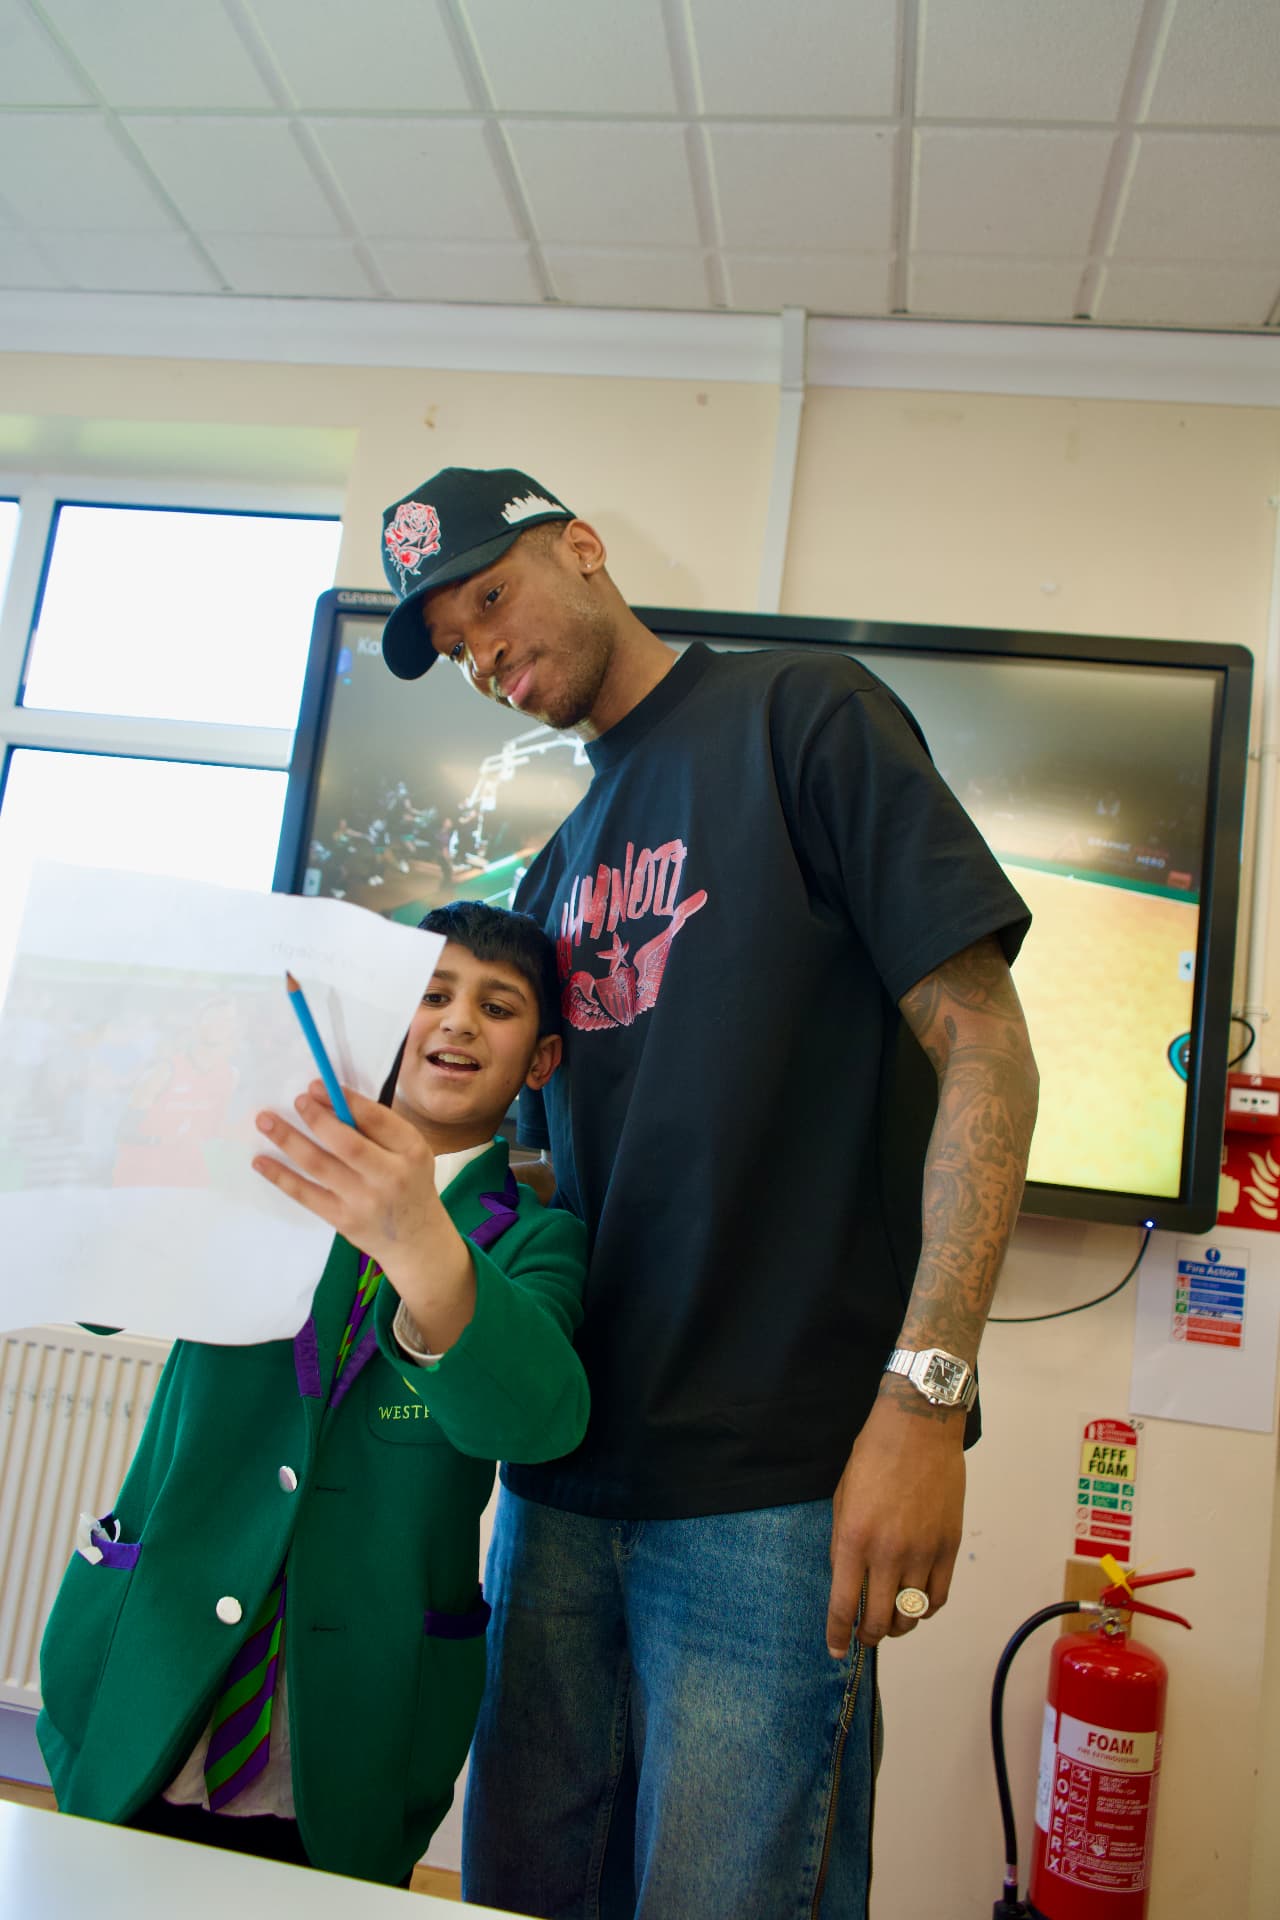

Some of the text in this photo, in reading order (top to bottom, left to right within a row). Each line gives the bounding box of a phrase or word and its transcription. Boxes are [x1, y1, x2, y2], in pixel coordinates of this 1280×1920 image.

[1186, 1263, 1239, 1280] Fire Action
[1093, 1447, 1127, 1461] AFFF
[1088, 1460, 1128, 1477] FOAM
[1087, 1732, 1135, 1754] FOAM
